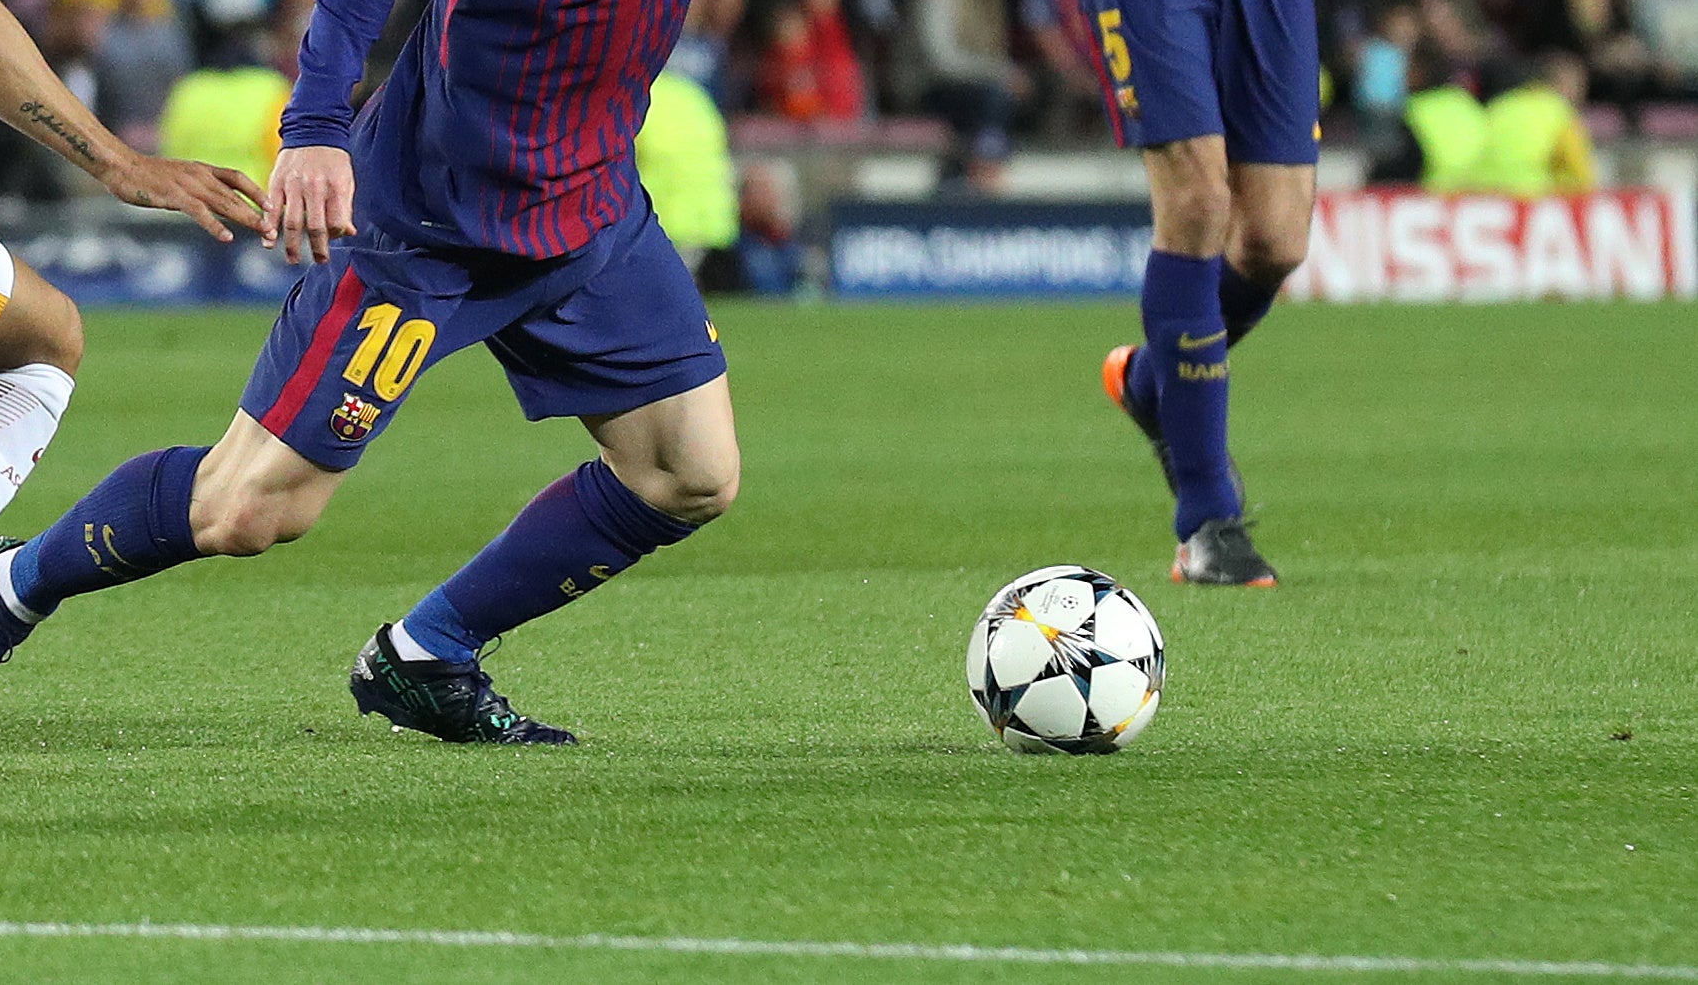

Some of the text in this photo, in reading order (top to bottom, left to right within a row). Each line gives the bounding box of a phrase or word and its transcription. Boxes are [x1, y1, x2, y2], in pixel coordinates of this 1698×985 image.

[1098, 8, 1133, 82] 5
[1285, 194, 1663, 300] NISSAN
[342, 302, 438, 402] 10
